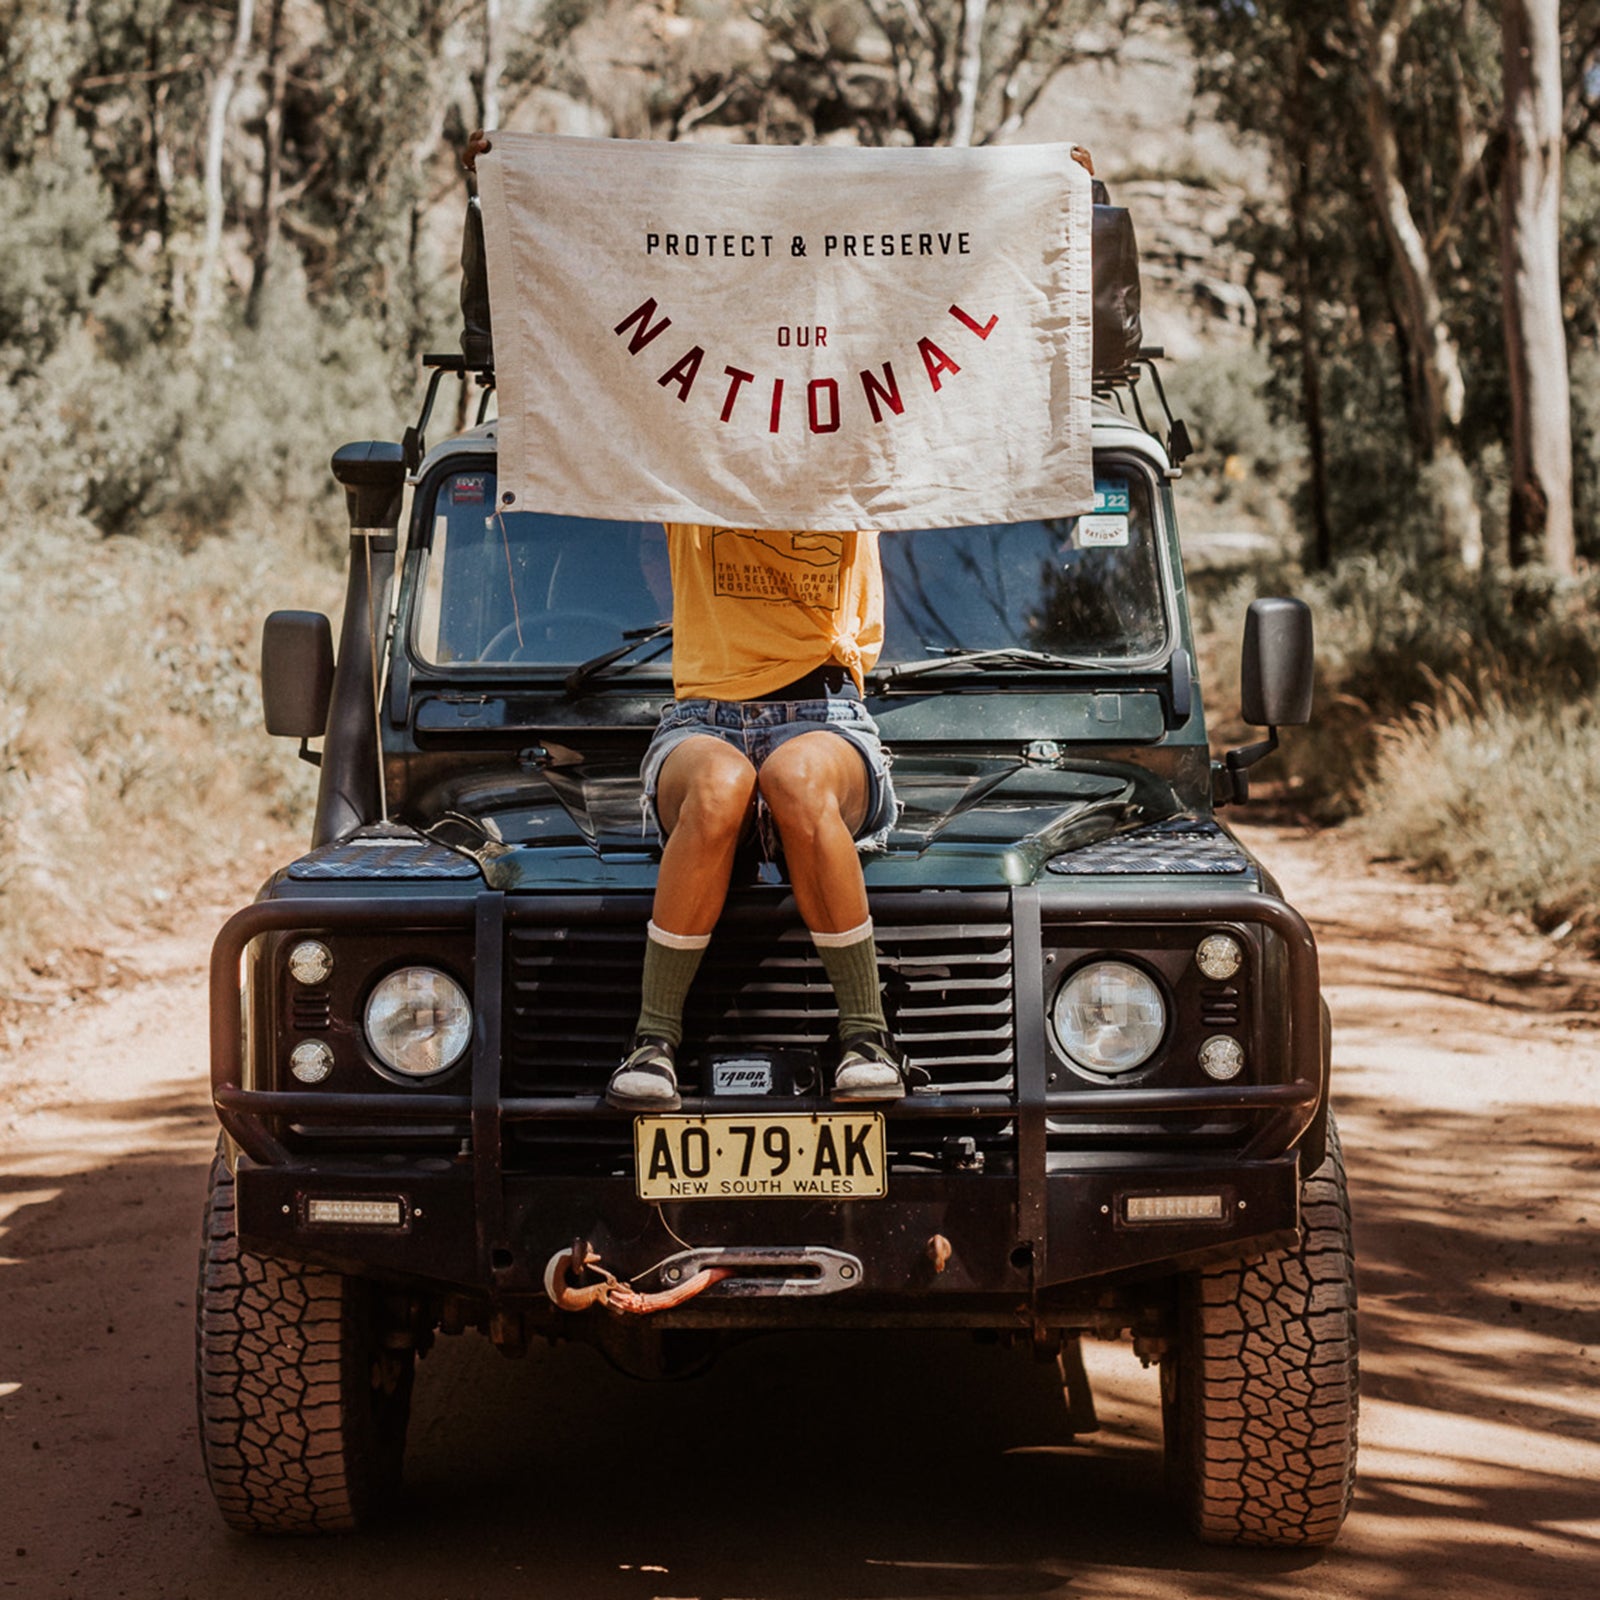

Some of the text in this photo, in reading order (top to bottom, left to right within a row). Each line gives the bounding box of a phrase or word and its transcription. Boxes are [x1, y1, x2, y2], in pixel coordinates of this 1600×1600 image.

[647, 232, 971, 258] PROTECT & PRESERVE
[777, 326, 828, 347] OUR
[614, 297, 998, 434] NATIONAL
[1108, 494, 1127, 507] 22
[720, 1071, 766, 1087] TABOR
[750, 1080, 767, 1088] 9K
[670, 1179, 854, 1195] NEW SOUTH WALES
